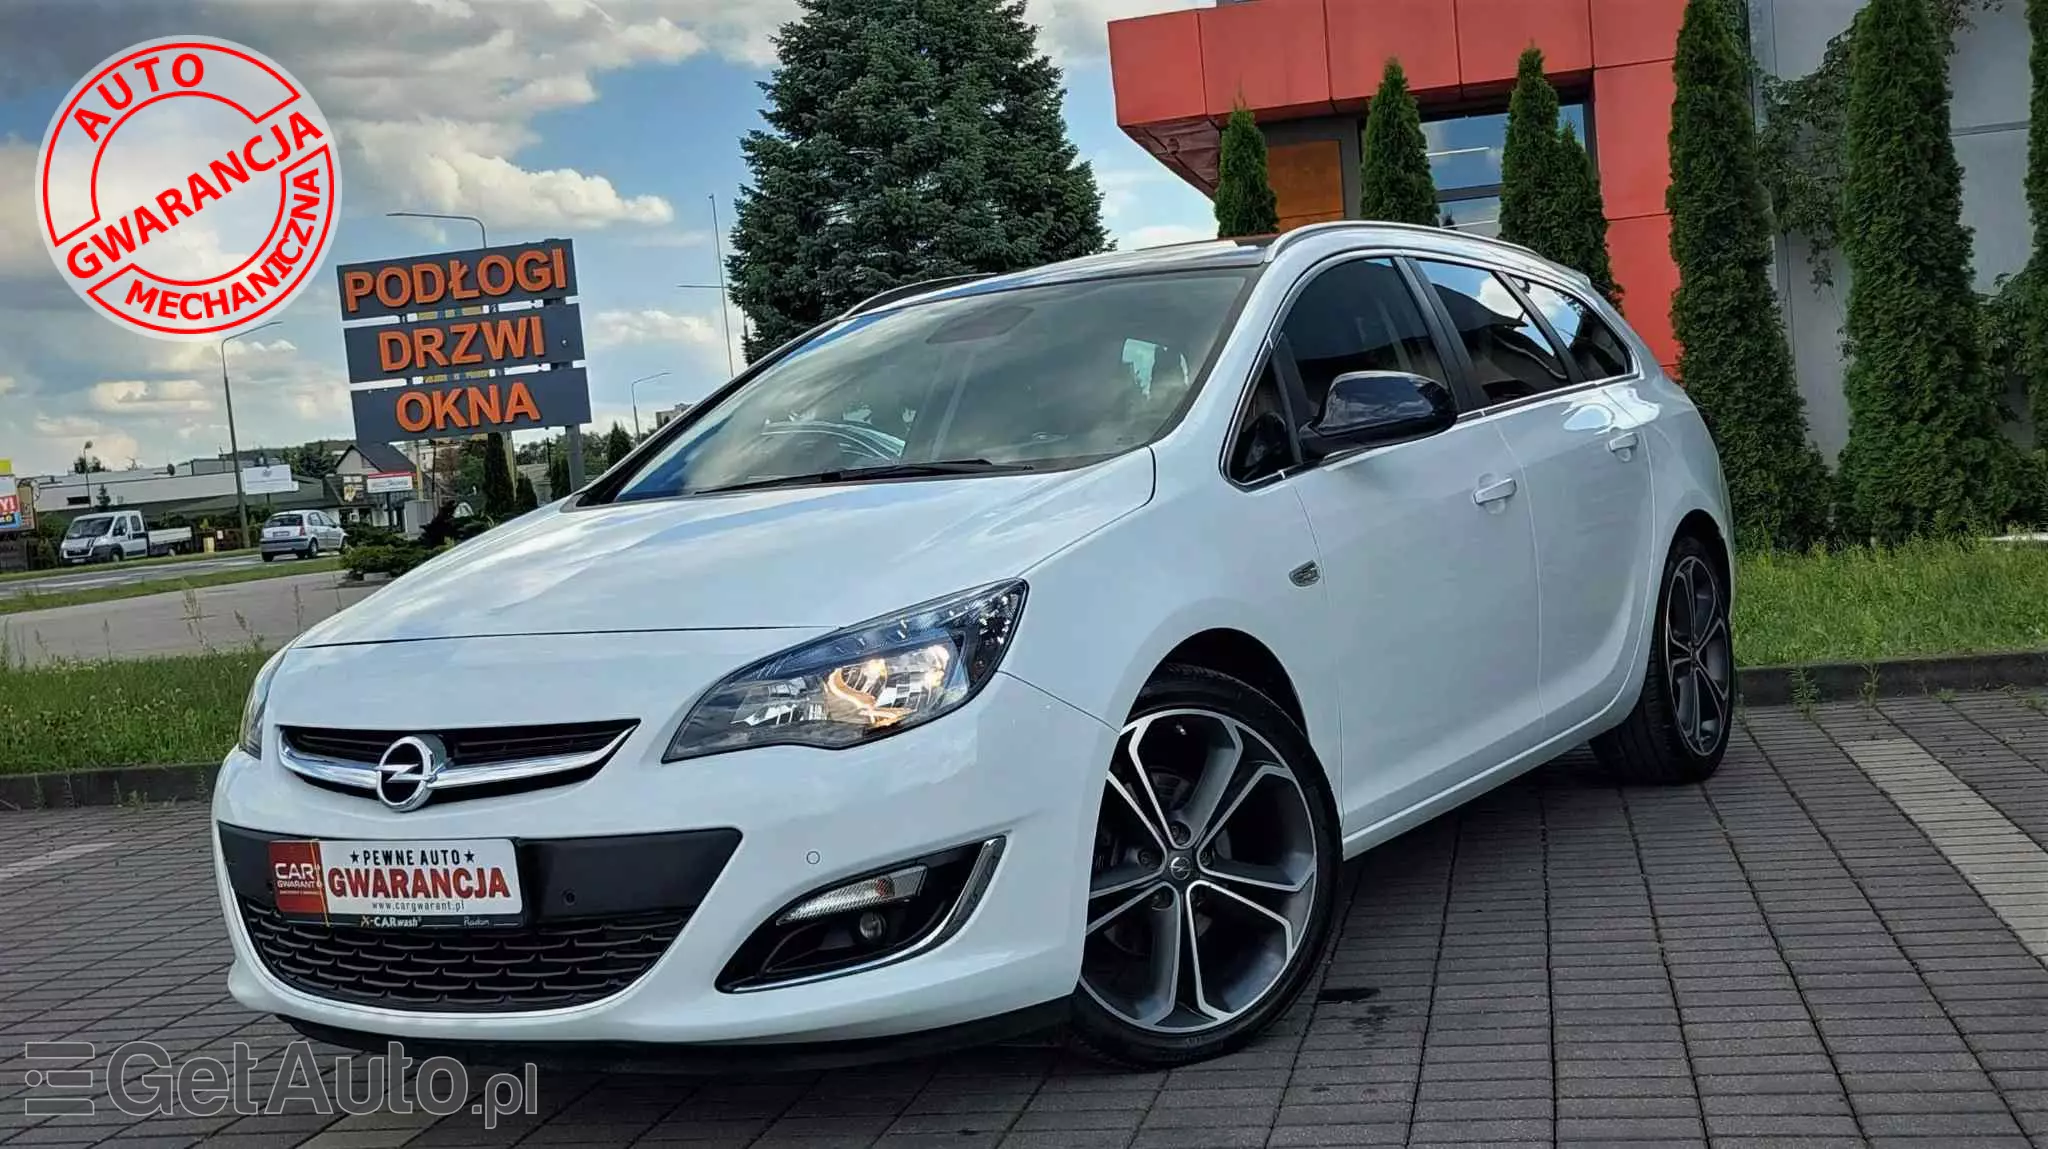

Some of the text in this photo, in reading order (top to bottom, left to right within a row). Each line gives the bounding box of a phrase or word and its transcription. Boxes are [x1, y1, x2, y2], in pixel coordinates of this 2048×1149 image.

[344, 248, 566, 312] PODŁOGI
[379, 316, 544, 372] DRZWI
[396, 382, 541, 432] OKNA
[275, 863, 314, 879] CAR
[364, 850, 460, 865] PEWNE AUTO
[328, 867, 510, 898] GWARANCJA
[372, 901, 465, 912] www.cargwarant.pl
